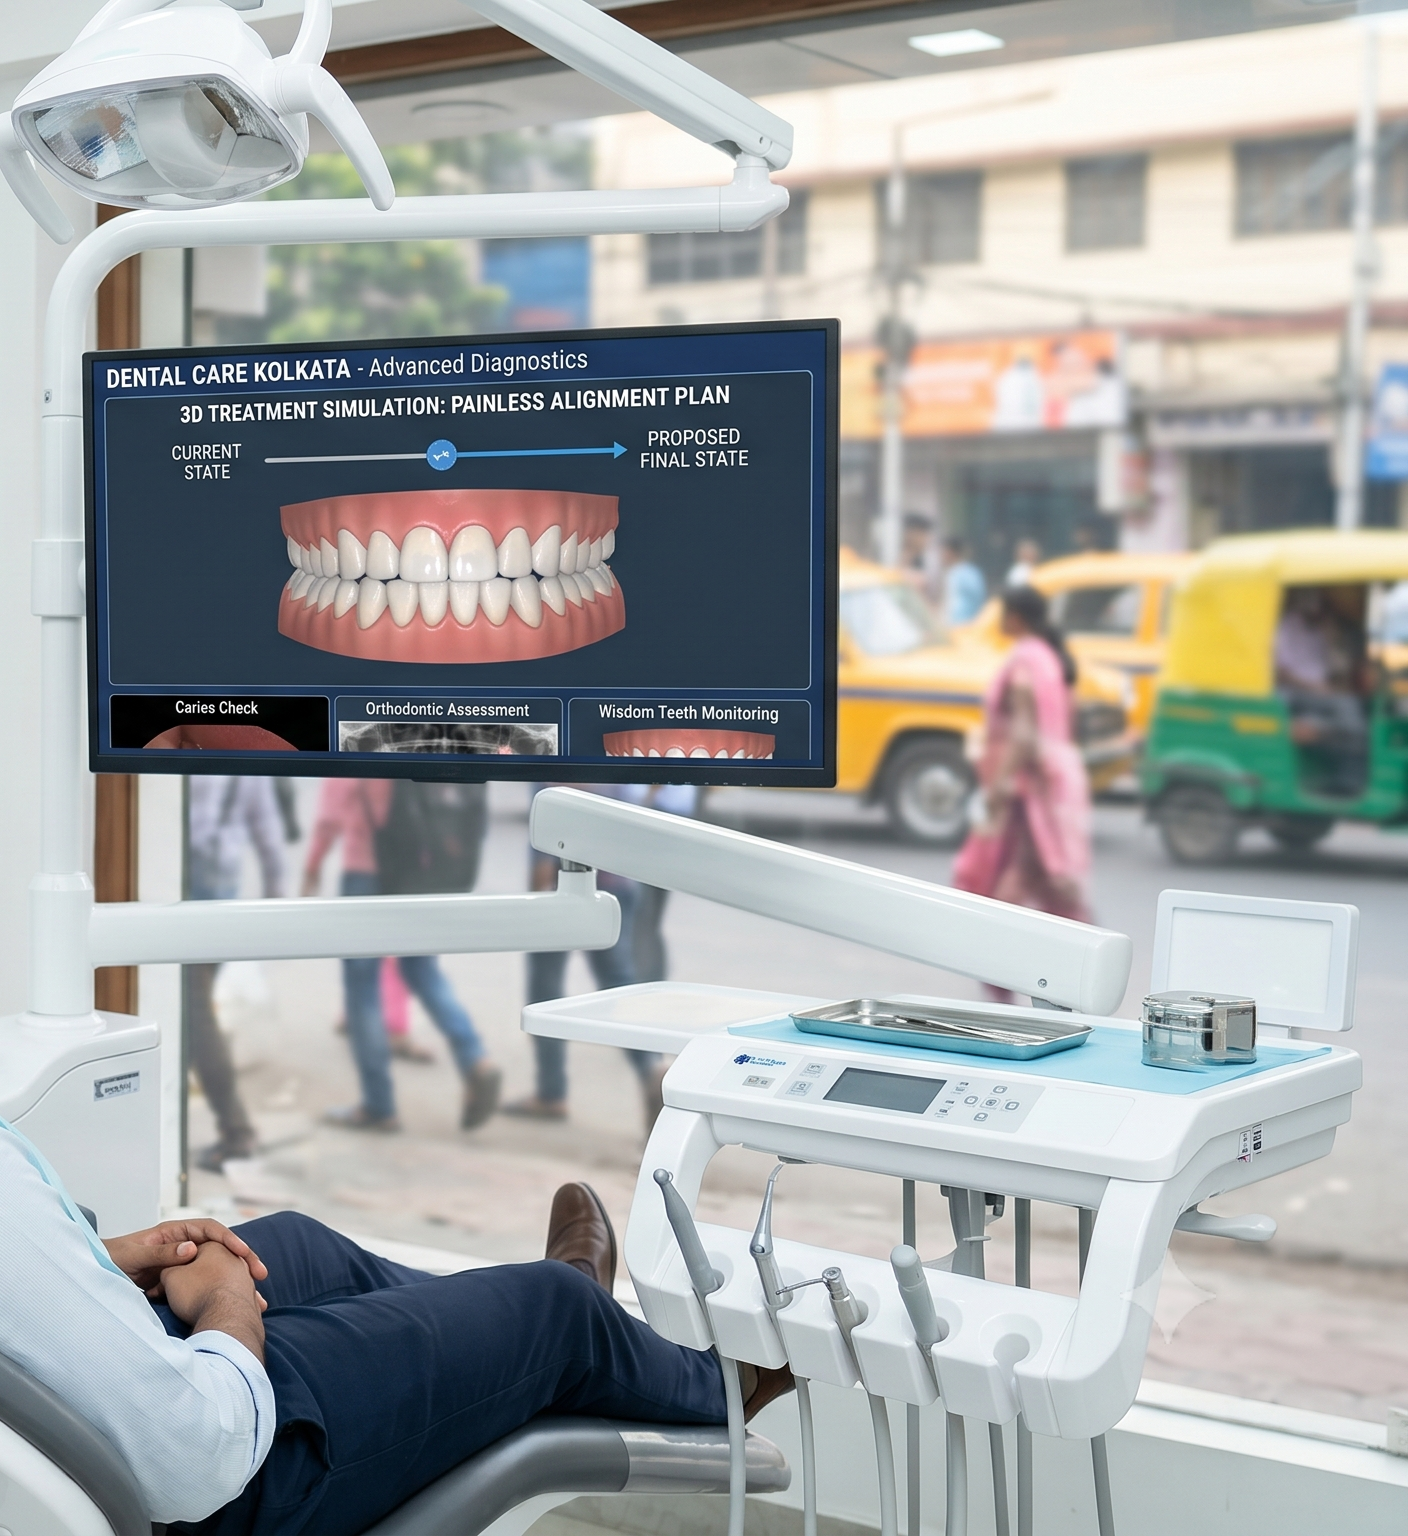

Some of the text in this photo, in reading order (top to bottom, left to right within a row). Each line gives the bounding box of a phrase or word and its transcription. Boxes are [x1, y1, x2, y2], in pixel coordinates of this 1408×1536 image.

[107, 365, 186, 389] DENTAL
[192, 362, 248, 385] CARE
[254, 358, 352, 383] KOLKATA
[368, 352, 464, 377] Advanced
[471, 349, 588, 377] Diagnostics
[180, 385, 730, 424] 3D TREATMENT SIMULATION: PAINLESS ALIGNMENT PLAN
[648, 428, 741, 447] PROPOSED
[171, 443, 242, 461] CURRENT
[640, 449, 749, 469] FINAL STATE
[184, 464, 231, 480] STATE
[175, 700, 259, 715] Caries Check
[365, 701, 530, 717] Orthodontic Assessment
[598, 704, 779, 725] Wisdom Teeth Monitoring
